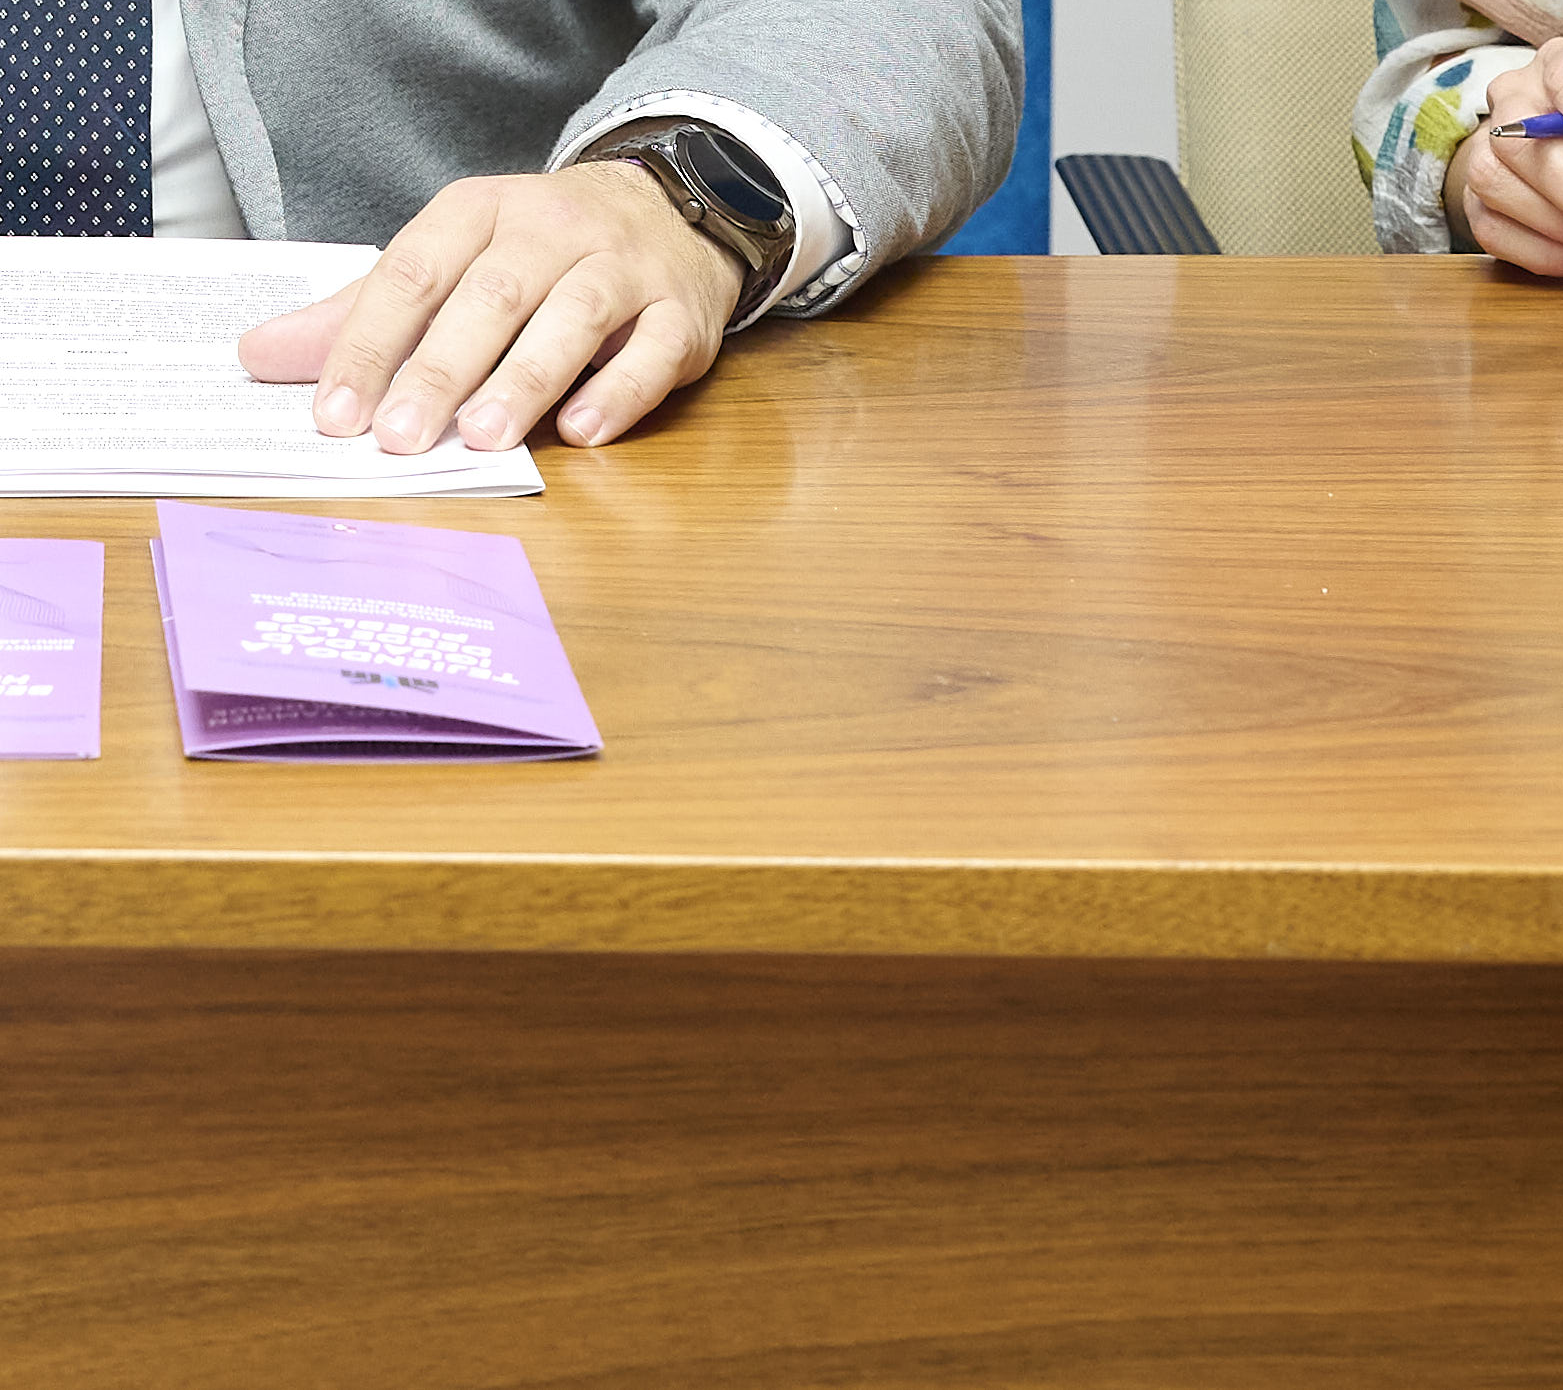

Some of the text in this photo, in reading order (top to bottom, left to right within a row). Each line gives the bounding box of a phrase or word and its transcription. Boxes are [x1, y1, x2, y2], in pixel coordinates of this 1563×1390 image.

[254, 619, 493, 658] DESDE LOS
[271, 612, 470, 644] PUEBLOS
[240, 639, 295, 655] LA
[260, 632, 492, 669] IGUALDAD
[304, 646, 521, 686] TEJIENDO
